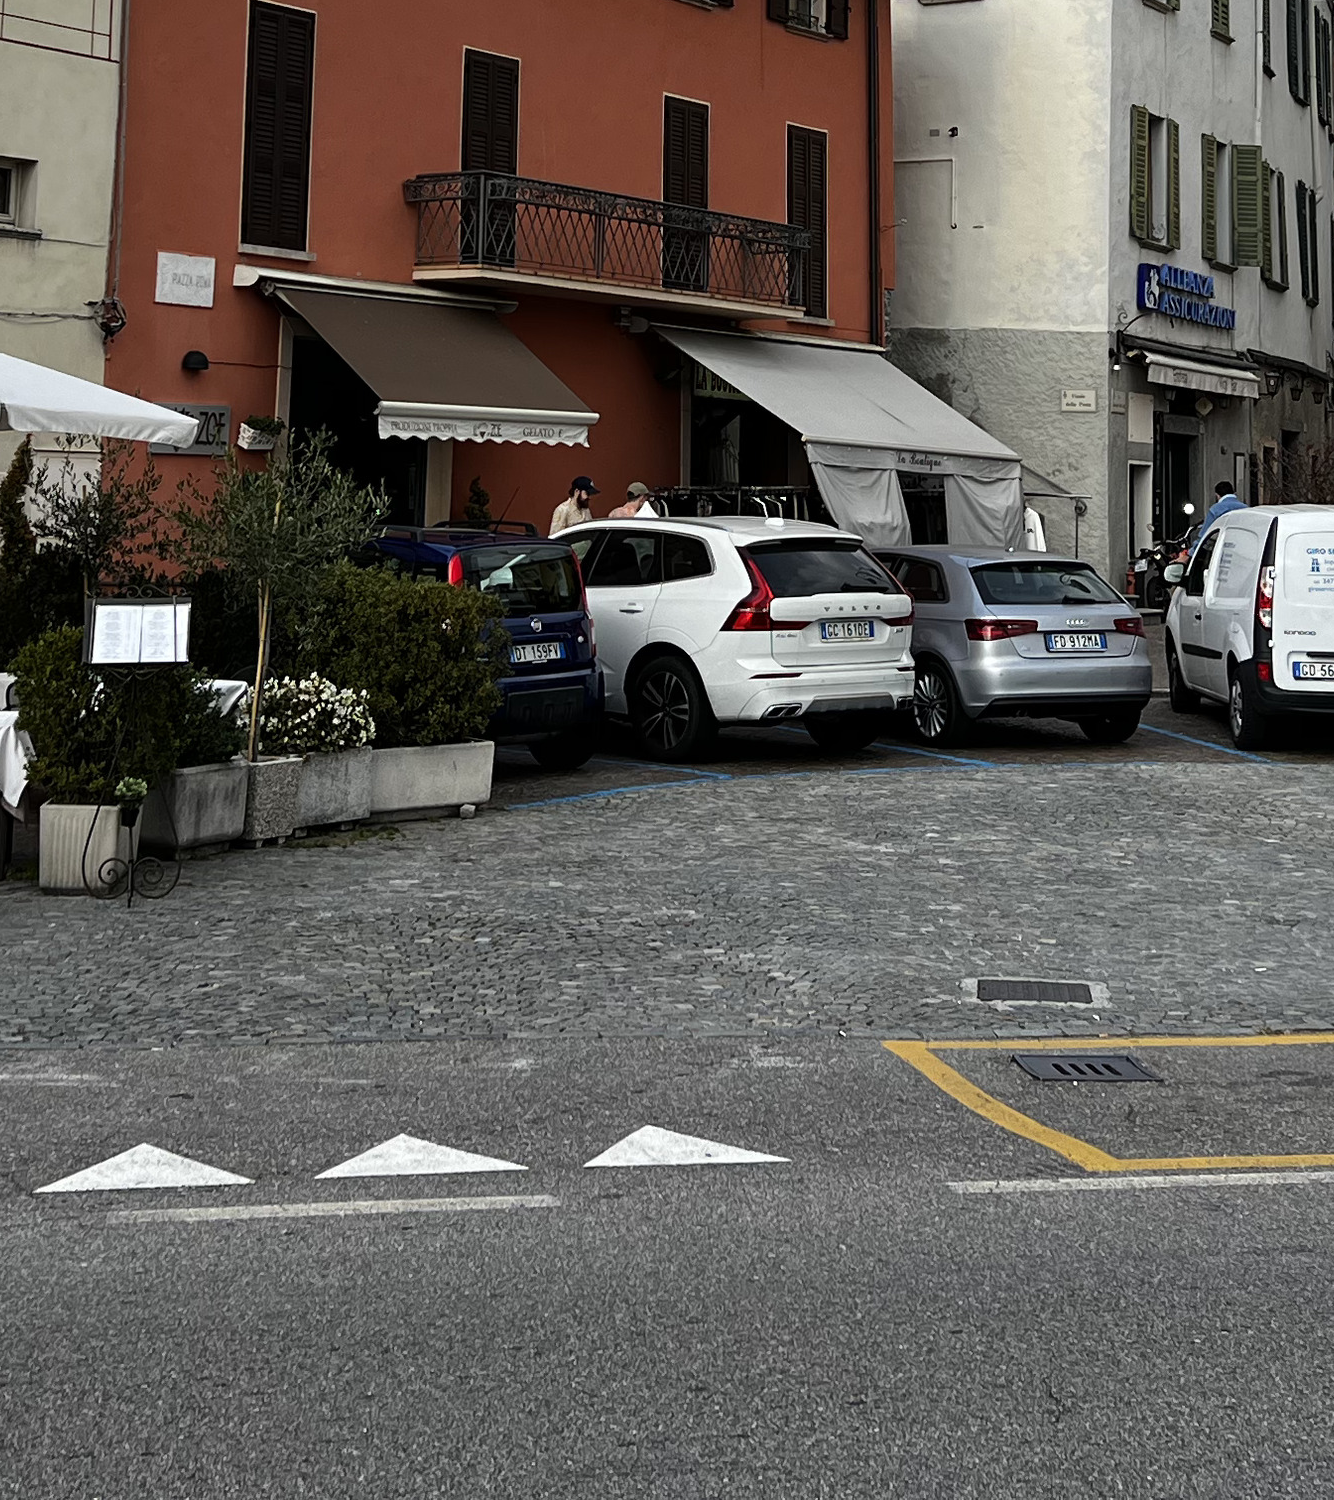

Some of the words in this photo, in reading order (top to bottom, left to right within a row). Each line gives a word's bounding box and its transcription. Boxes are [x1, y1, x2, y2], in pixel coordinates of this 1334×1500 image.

[1160, 264, 1215, 298] ALLEANZA
[522, 426, 555, 438] GELATO
[1306, 547, 1326, 555] GIRO
[824, 604, 881, 612] VOLVO
[515, 646, 526, 661] DT
